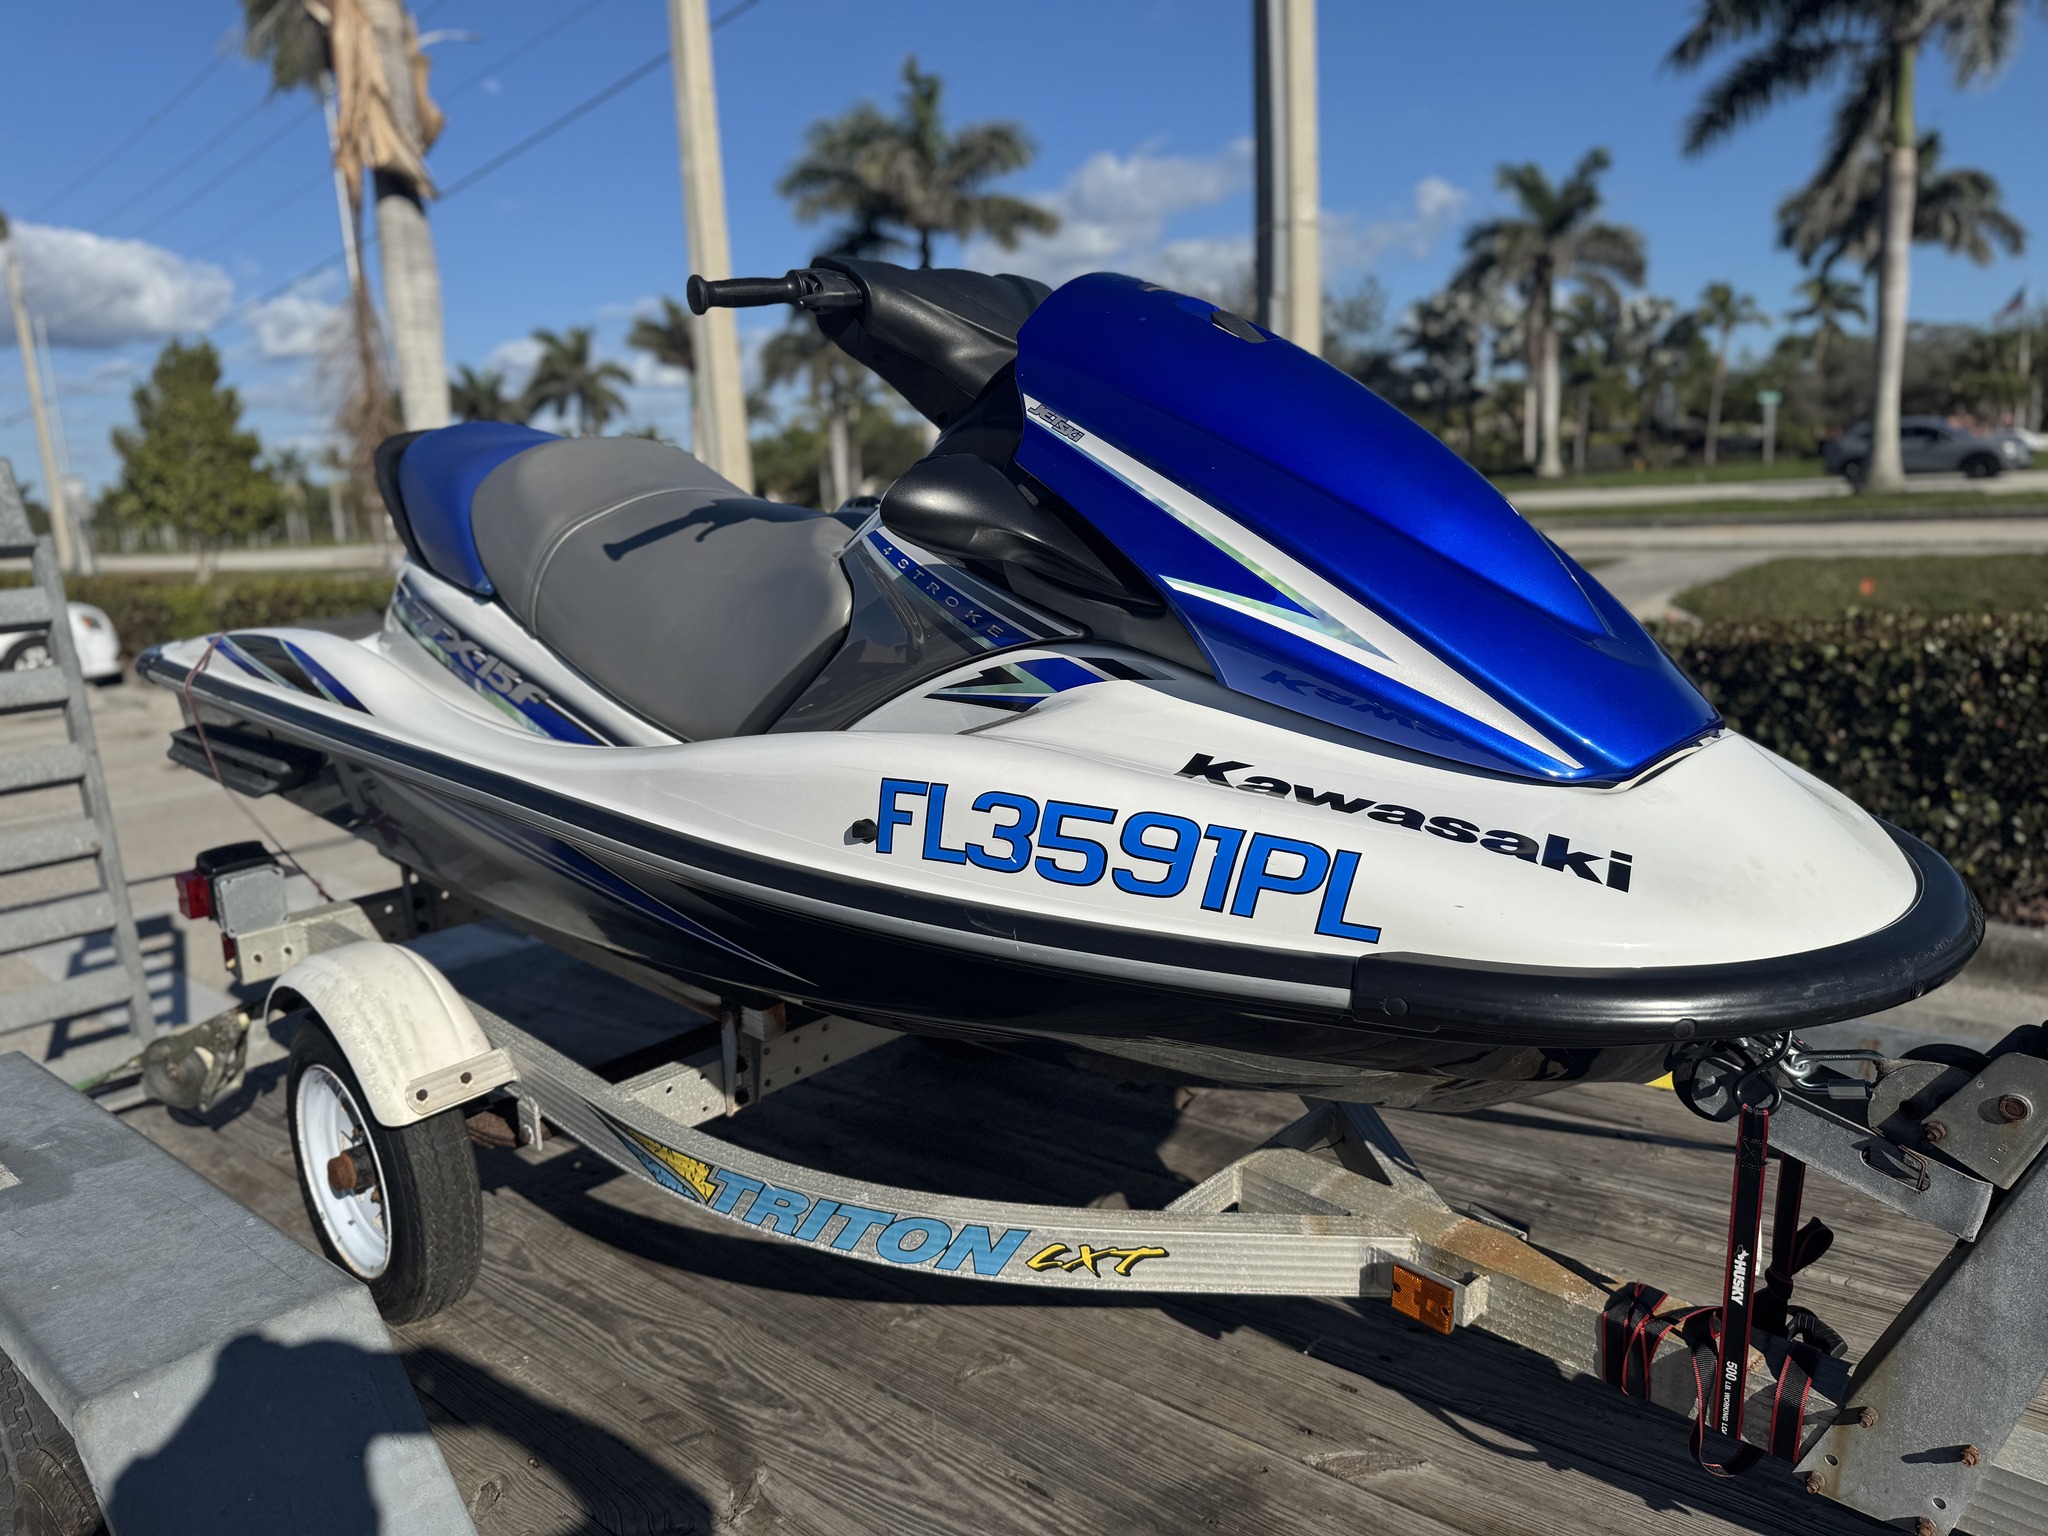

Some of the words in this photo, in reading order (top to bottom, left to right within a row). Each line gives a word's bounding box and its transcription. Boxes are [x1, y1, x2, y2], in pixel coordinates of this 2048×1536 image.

[883, 546, 893, 556] 4
[897, 558, 1004, 638] STROKE
[1173, 752, 1632, 893] Kawasaki
[708, 1167, 1031, 1277] TRITON
[1731, 1258, 1747, 1306] HUSKY
[1725, 1360, 1738, 1382] 500
[1721, 1391, 1731, 1422] WORKING
